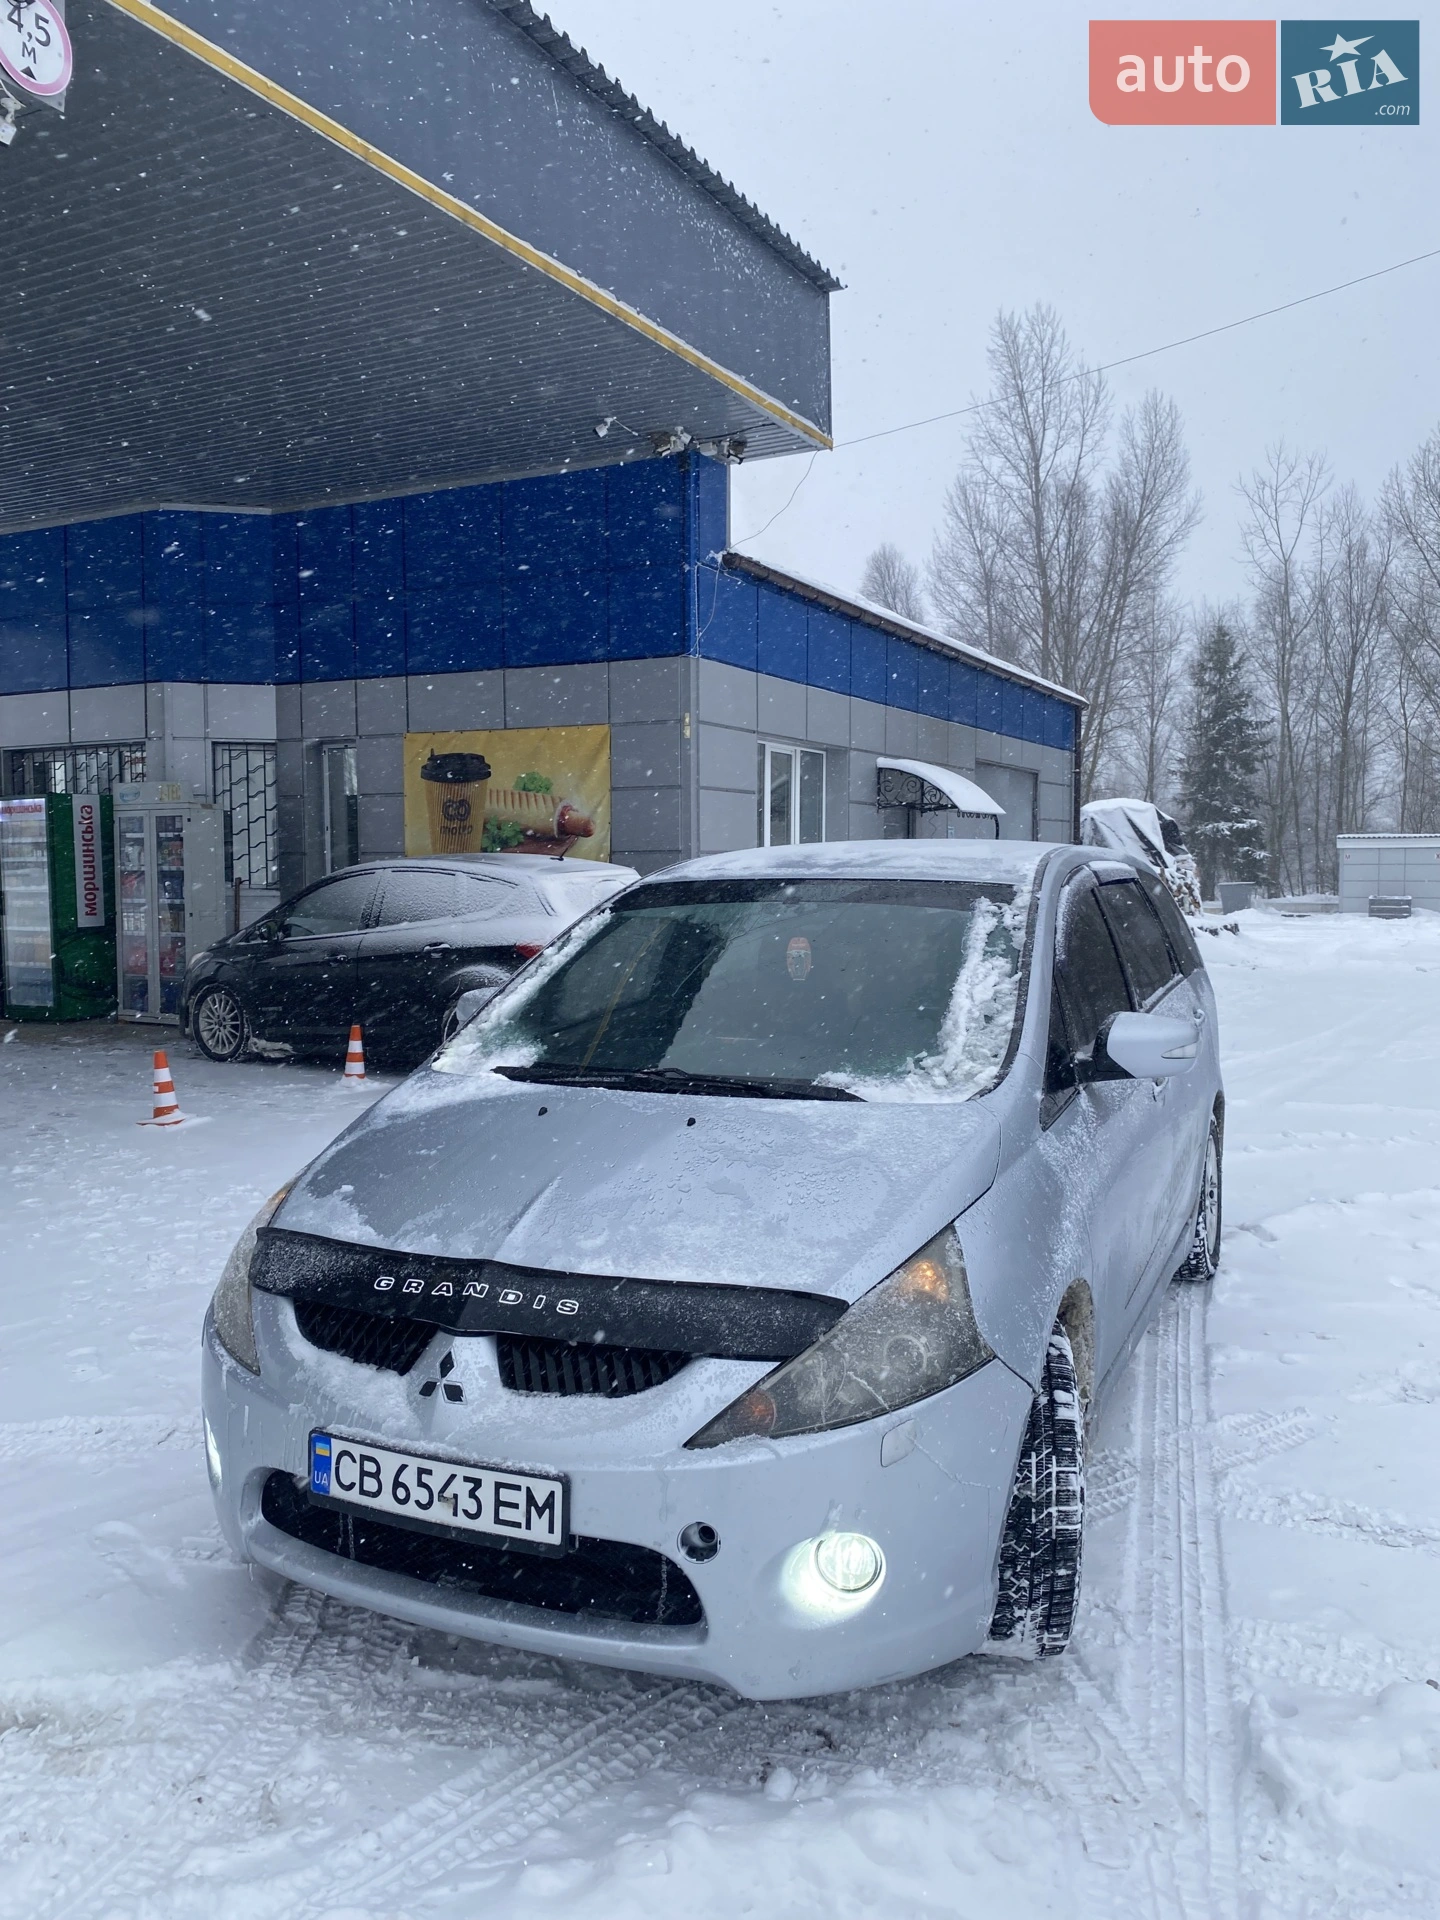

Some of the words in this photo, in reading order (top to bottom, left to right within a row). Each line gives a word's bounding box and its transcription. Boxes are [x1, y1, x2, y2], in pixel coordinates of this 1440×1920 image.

[7, 5, 51, 47] 4,5
[374, 1276, 580, 1315] GRANDIS
[314, 1470, 329, 1487] UA
[334, 1449, 383, 1498] CB
[391, 1463, 483, 1520] 6543
[493, 1480, 556, 1534] EM
